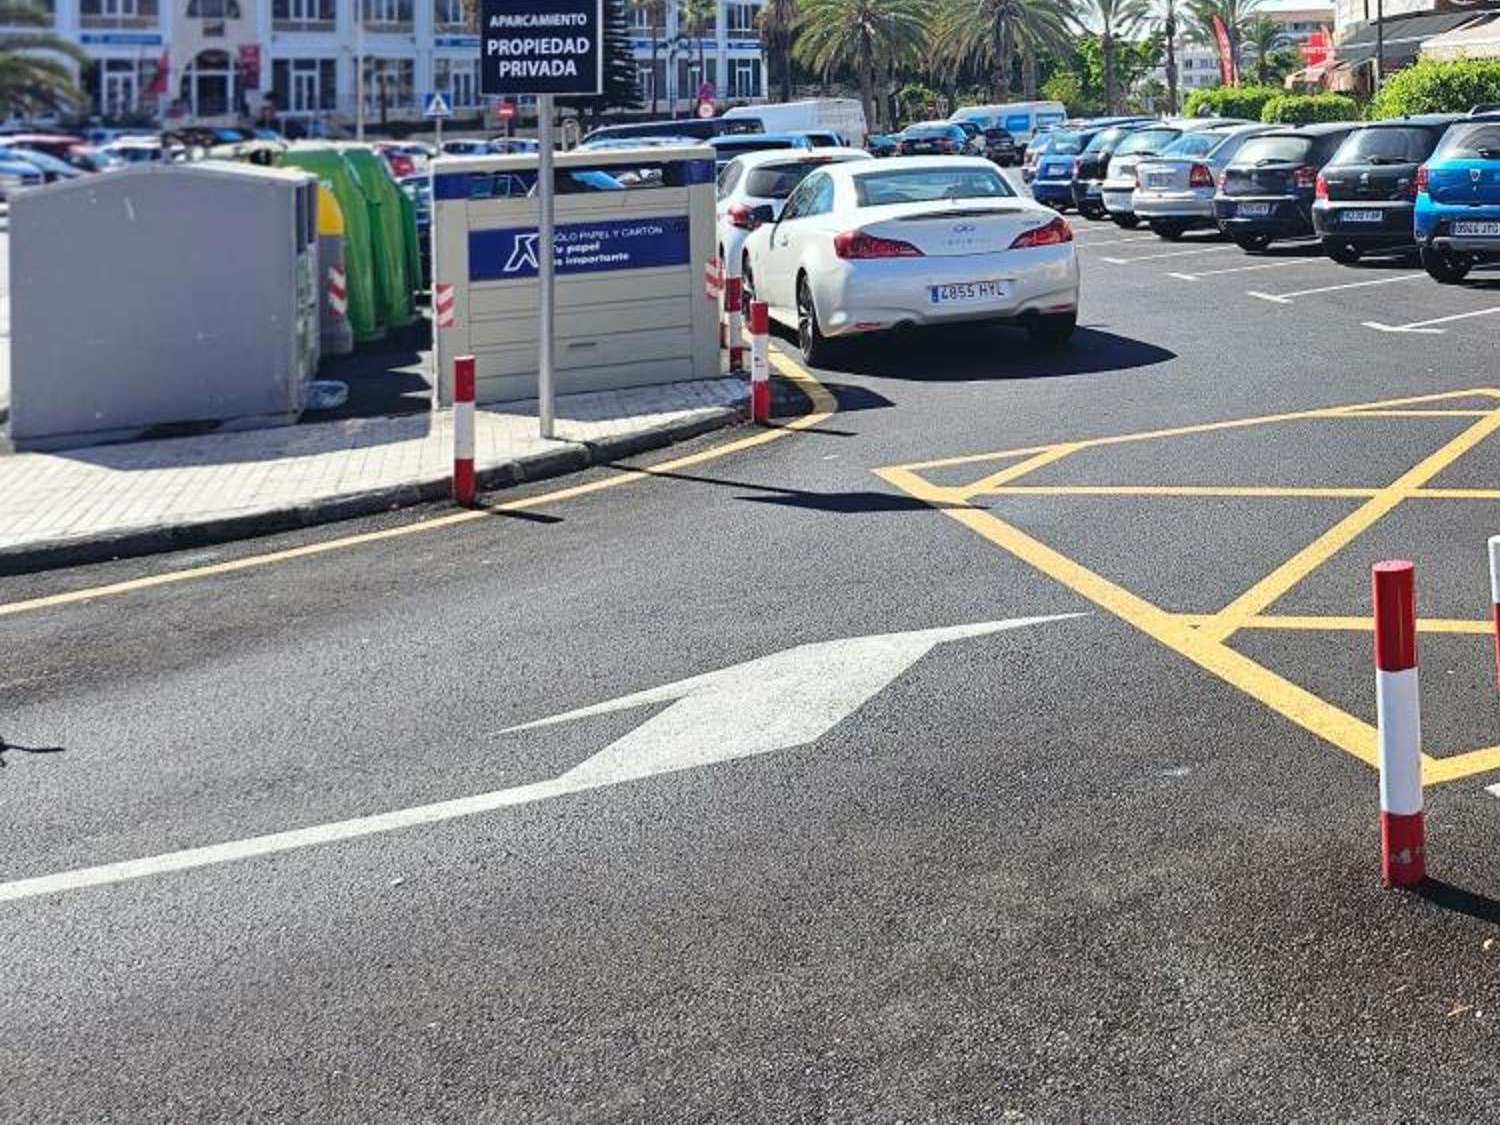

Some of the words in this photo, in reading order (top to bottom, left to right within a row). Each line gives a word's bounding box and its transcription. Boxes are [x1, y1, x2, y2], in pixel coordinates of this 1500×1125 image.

[489, 13, 587, 28] APARCAMIENTO
[487, 36, 590, 55] PROPIEDAD
[499, 59, 577, 78] PRIVADA
[580, 230, 609, 240] PAPEL
[567, 240, 600, 255] papel
[565, 252, 630, 265] importante
